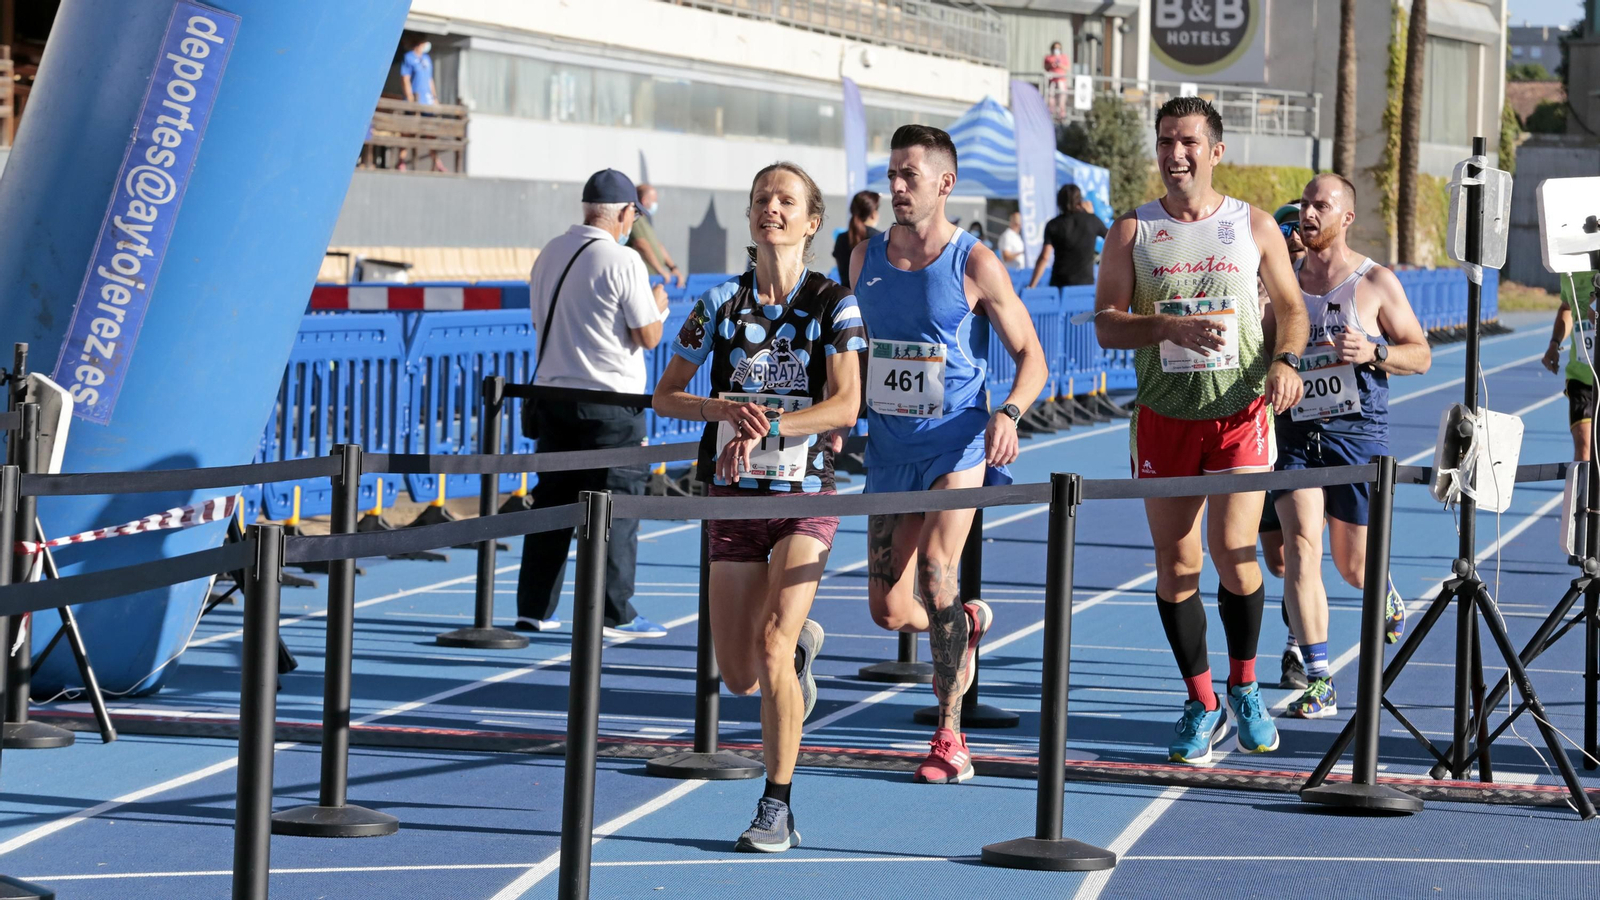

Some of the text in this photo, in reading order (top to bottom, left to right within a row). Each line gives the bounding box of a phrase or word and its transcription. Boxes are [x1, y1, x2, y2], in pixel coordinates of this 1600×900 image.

[1156, 0, 1246, 28] B&B
[1166, 31, 1231, 45] HOTELS
[69, 15, 224, 408] deportes@aytojerez.es
[1151, 255, 1240, 277] maratón
[1176, 278, 1215, 286] JEREZ
[733, 359, 751, 382] TRAIL
[753, 363, 806, 382] PIRATA
[884, 369, 924, 393] 461
[761, 380, 792, 390] Jerez
[1303, 376, 1342, 399] 200
